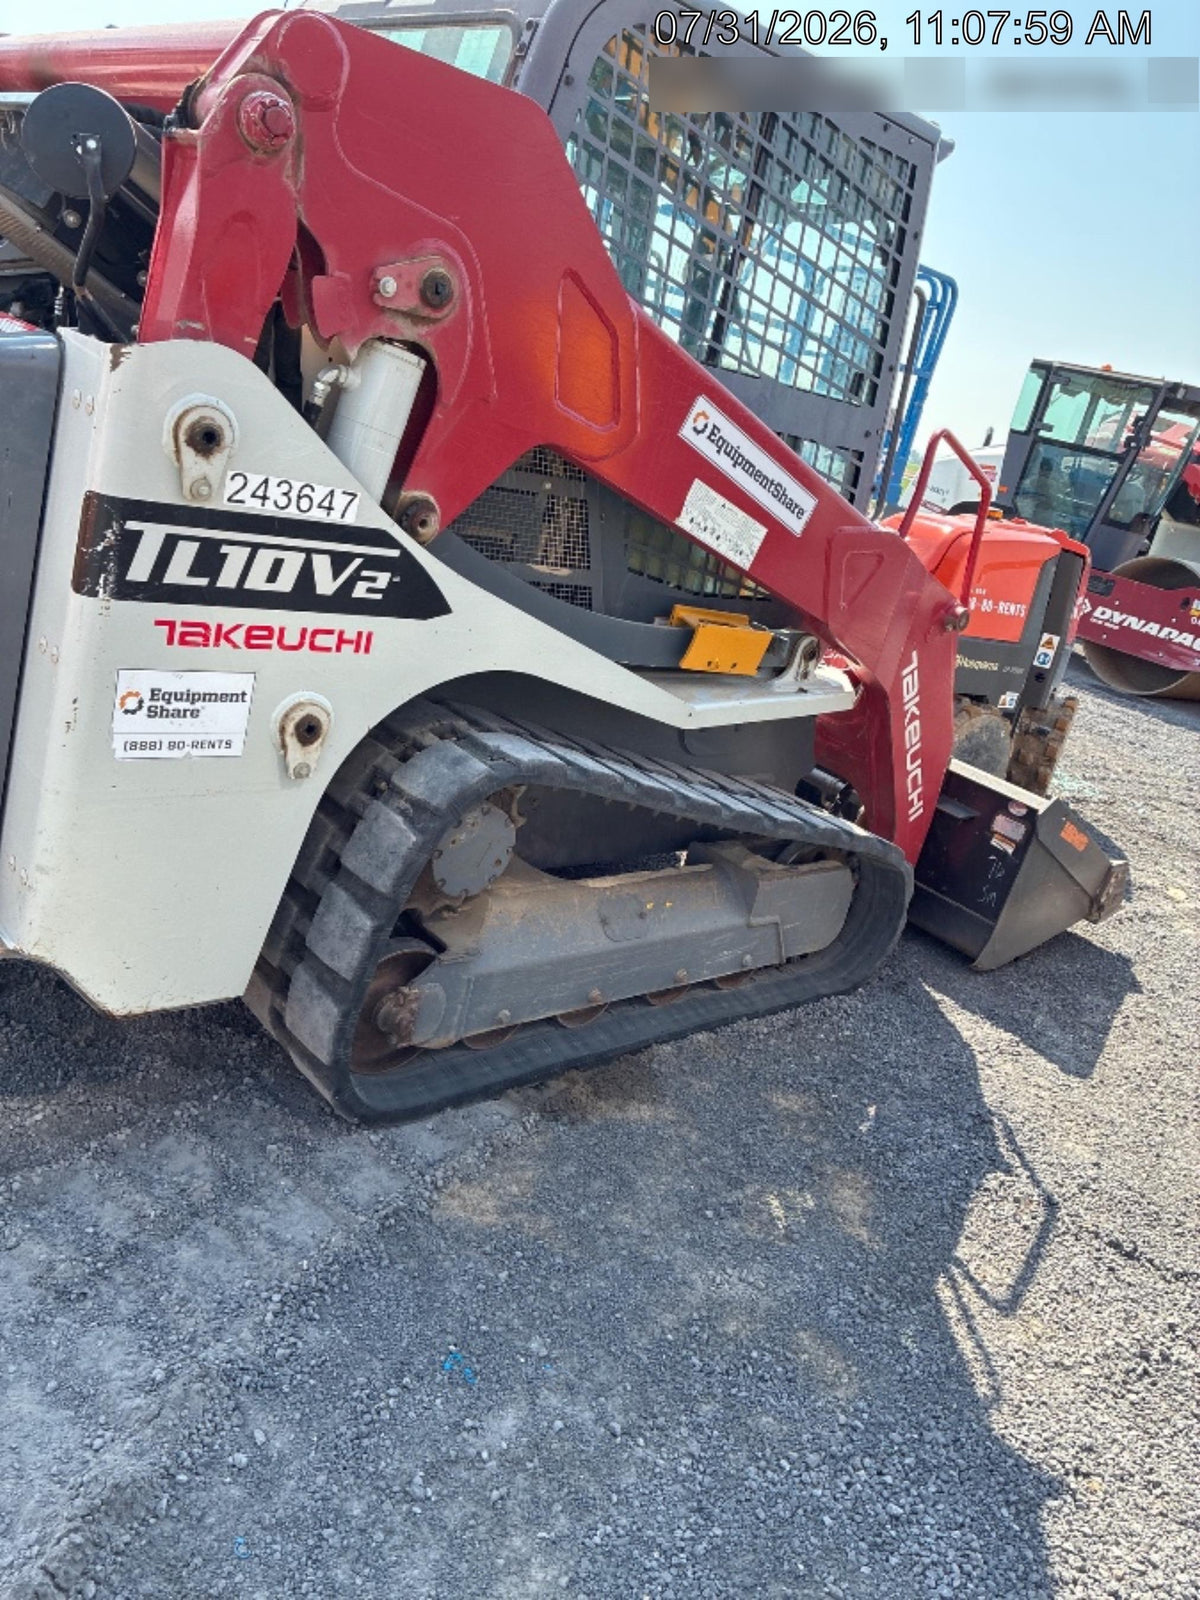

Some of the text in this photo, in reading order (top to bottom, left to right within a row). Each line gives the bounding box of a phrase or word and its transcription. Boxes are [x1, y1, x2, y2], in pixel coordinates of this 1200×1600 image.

[707, 424, 806, 519] EquipmentShare
[227, 472, 358, 520] 243647
[154, 619, 374, 655] TAKEUCHI
[146, 705, 201, 719] Share
[148, 687, 247, 705] Equipment
[123, 740, 162, 753] (888)
[901, 650, 925, 822] TAKEUCHI
